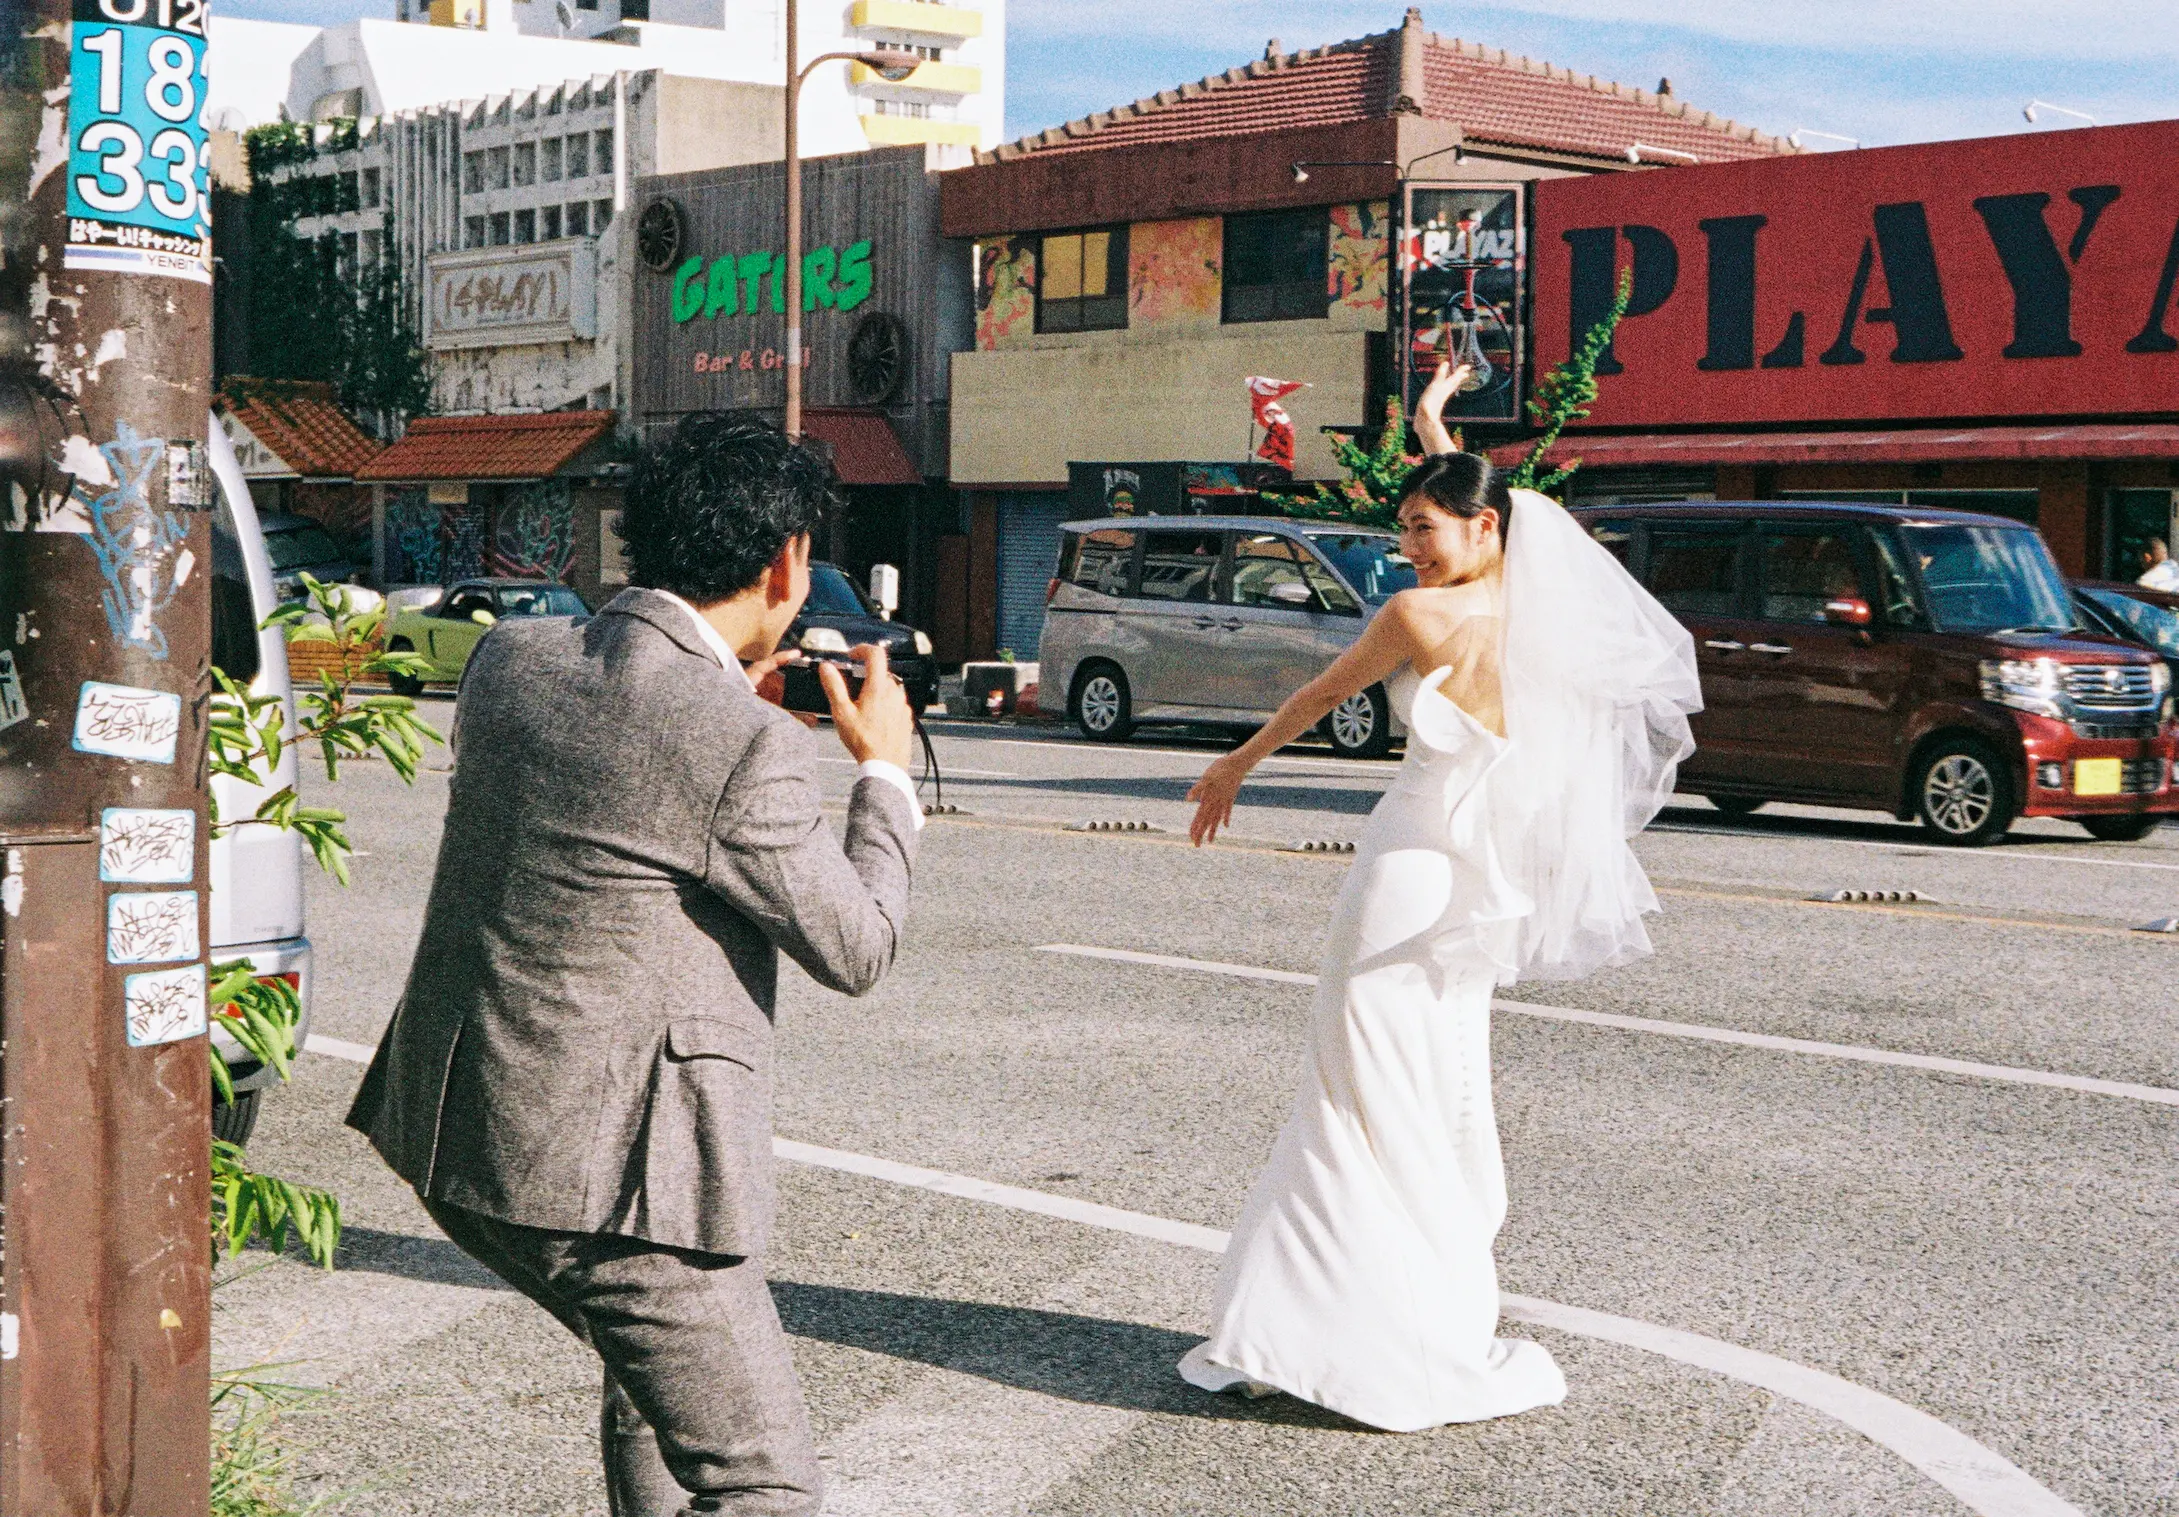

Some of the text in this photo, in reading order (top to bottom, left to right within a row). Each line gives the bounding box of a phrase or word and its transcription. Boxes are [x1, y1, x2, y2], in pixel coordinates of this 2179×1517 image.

[82, 28, 209, 132] 18
[76, 119, 212, 227] 33
[694, 347, 810, 373] Bar & Grl
